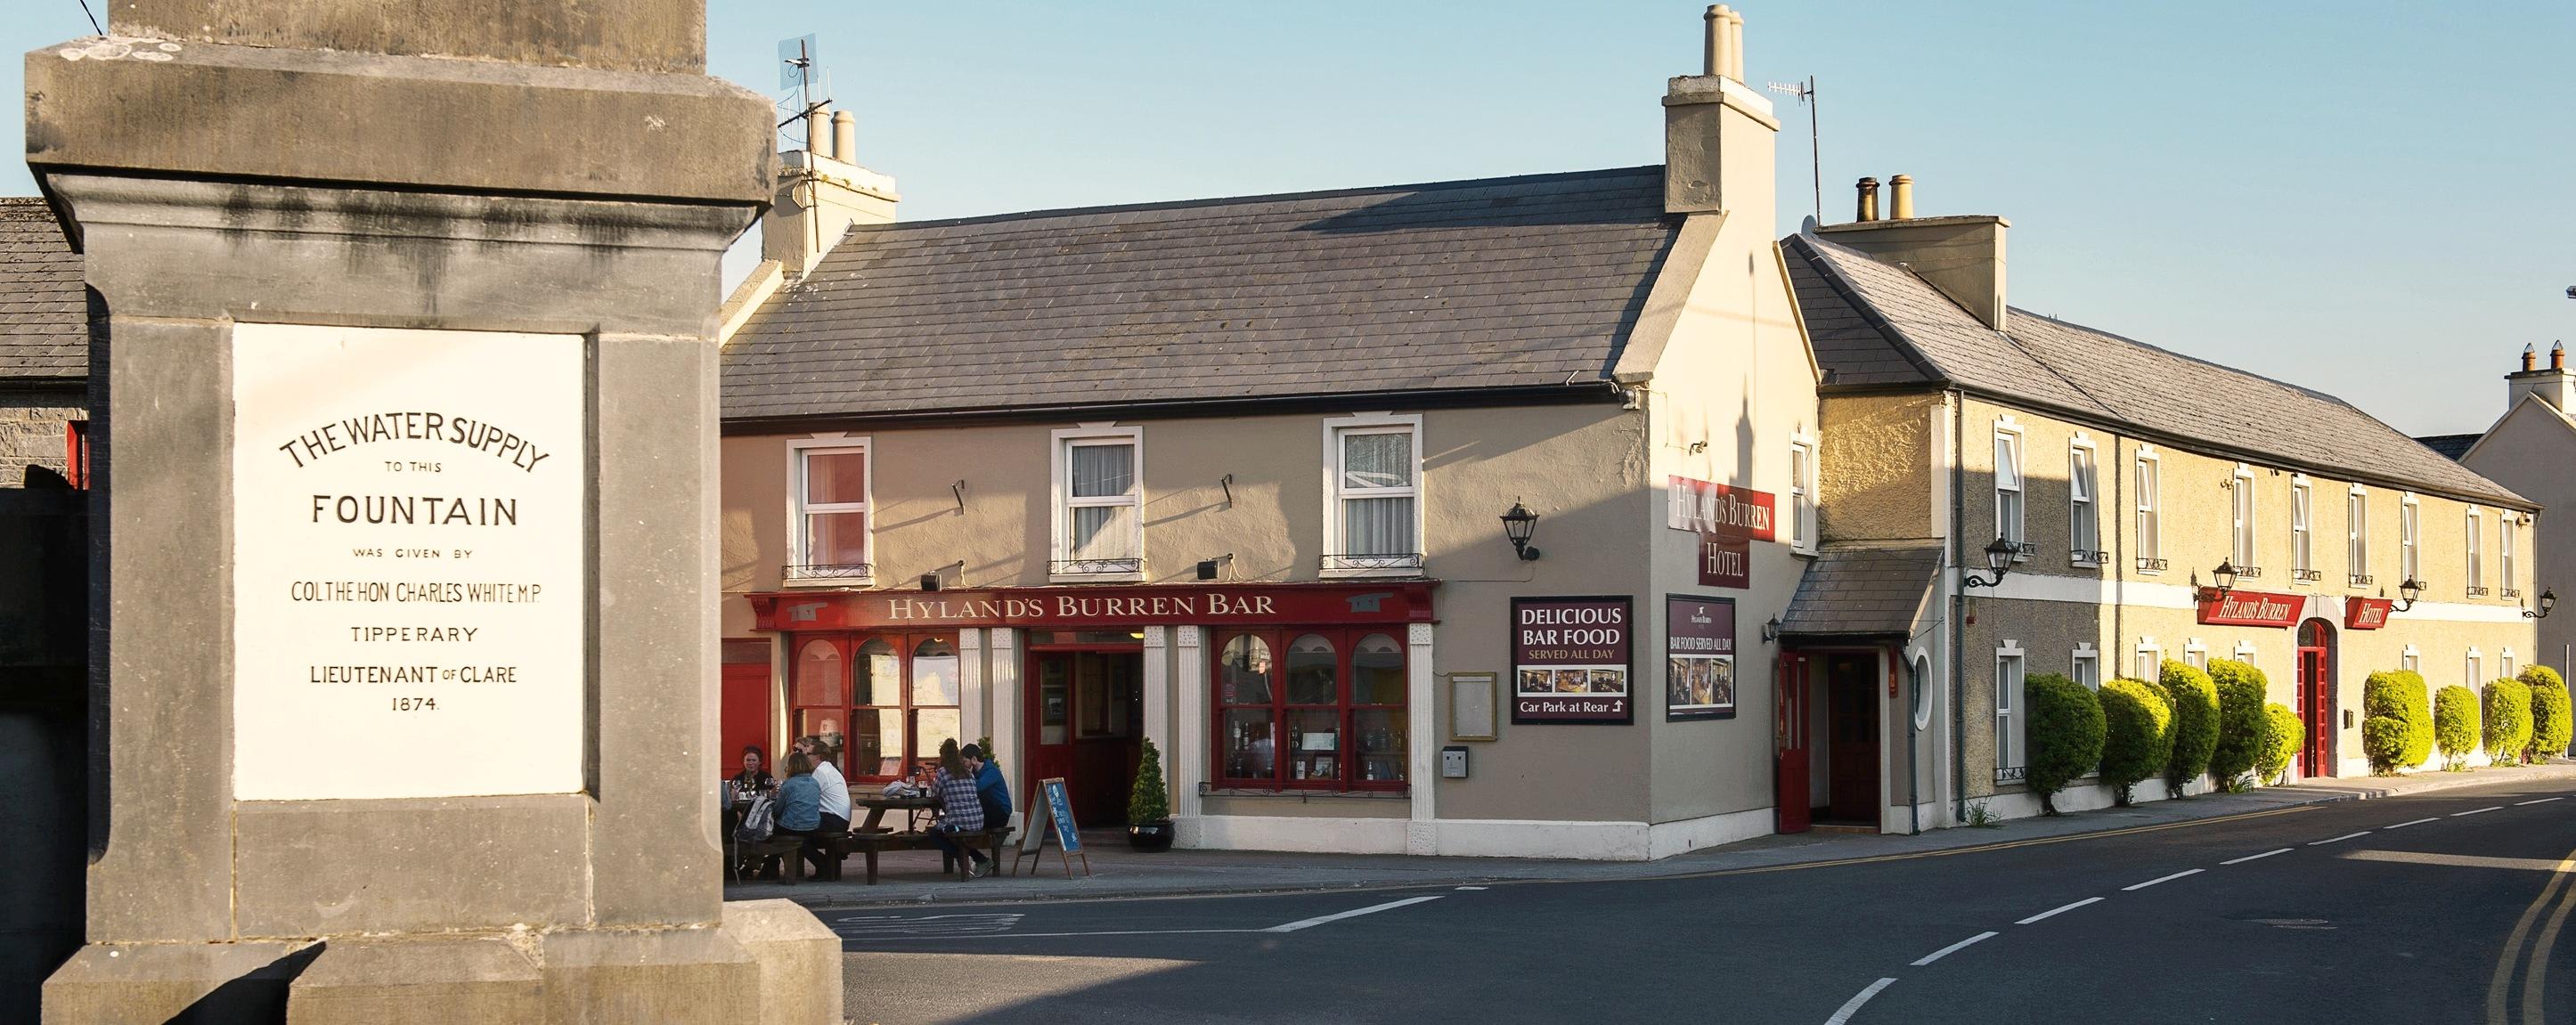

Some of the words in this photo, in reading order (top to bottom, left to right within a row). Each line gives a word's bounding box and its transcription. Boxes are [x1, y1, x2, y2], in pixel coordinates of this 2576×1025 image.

[279, 423, 346, 468] THE
[342, 411, 444, 445] WATER
[448, 416, 550, 473] SUPPLY
[384, 460, 403, 472] TO
[409, 461, 442, 473] THIS
[312, 494, 518, 526] FOUNTAIN
[1675, 484, 1726, 524] HYLAND'S
[1728, 493, 1770, 531] BURREN
[353, 548, 383, 557] WAS
[395, 548, 440, 558] GIVEN
[453, 549, 473, 559] BY
[1707, 541, 1744, 577] HOTEL
[324, 581, 355, 602] THE
[395, 582, 462, 603] CHARLES
[467, 582, 514, 604] WHITE
[887, 598, 1045, 620] HYLAND'S
[1056, 595, 1196, 617] BURREN
[1206, 593, 1277, 615] BAR
[1521, 607, 1623, 625] DELICIOUS
[2256, 598, 2292, 621] BURREN
[2359, 603, 2384, 623] HOTEL
[350, 626, 479, 643] TIPPERARY
[1523, 630, 1559, 646] BAR
[1563, 629, 1621, 646] FOOD
[1670, 637, 1680, 649] BAR
[1681, 637, 1695, 650] FOOD
[1696, 638, 1713, 650] SERVED
[1722, 639, 1732, 650] DAY
[1528, 649, 1569, 660] SERVED
[1570, 650, 1590, 660] ALL
[1593, 649, 1615, 660] DAY
[310, 665, 439, 684] LIEUTENANT
[442, 668, 458, 681] OF
[460, 665, 518, 684] CLARE
[1520, 702, 1540, 712] Car
[1543, 701, 1566, 712] Park
[1569, 703, 1580, 712] at
[1583, 702, 1609, 712] Rear
